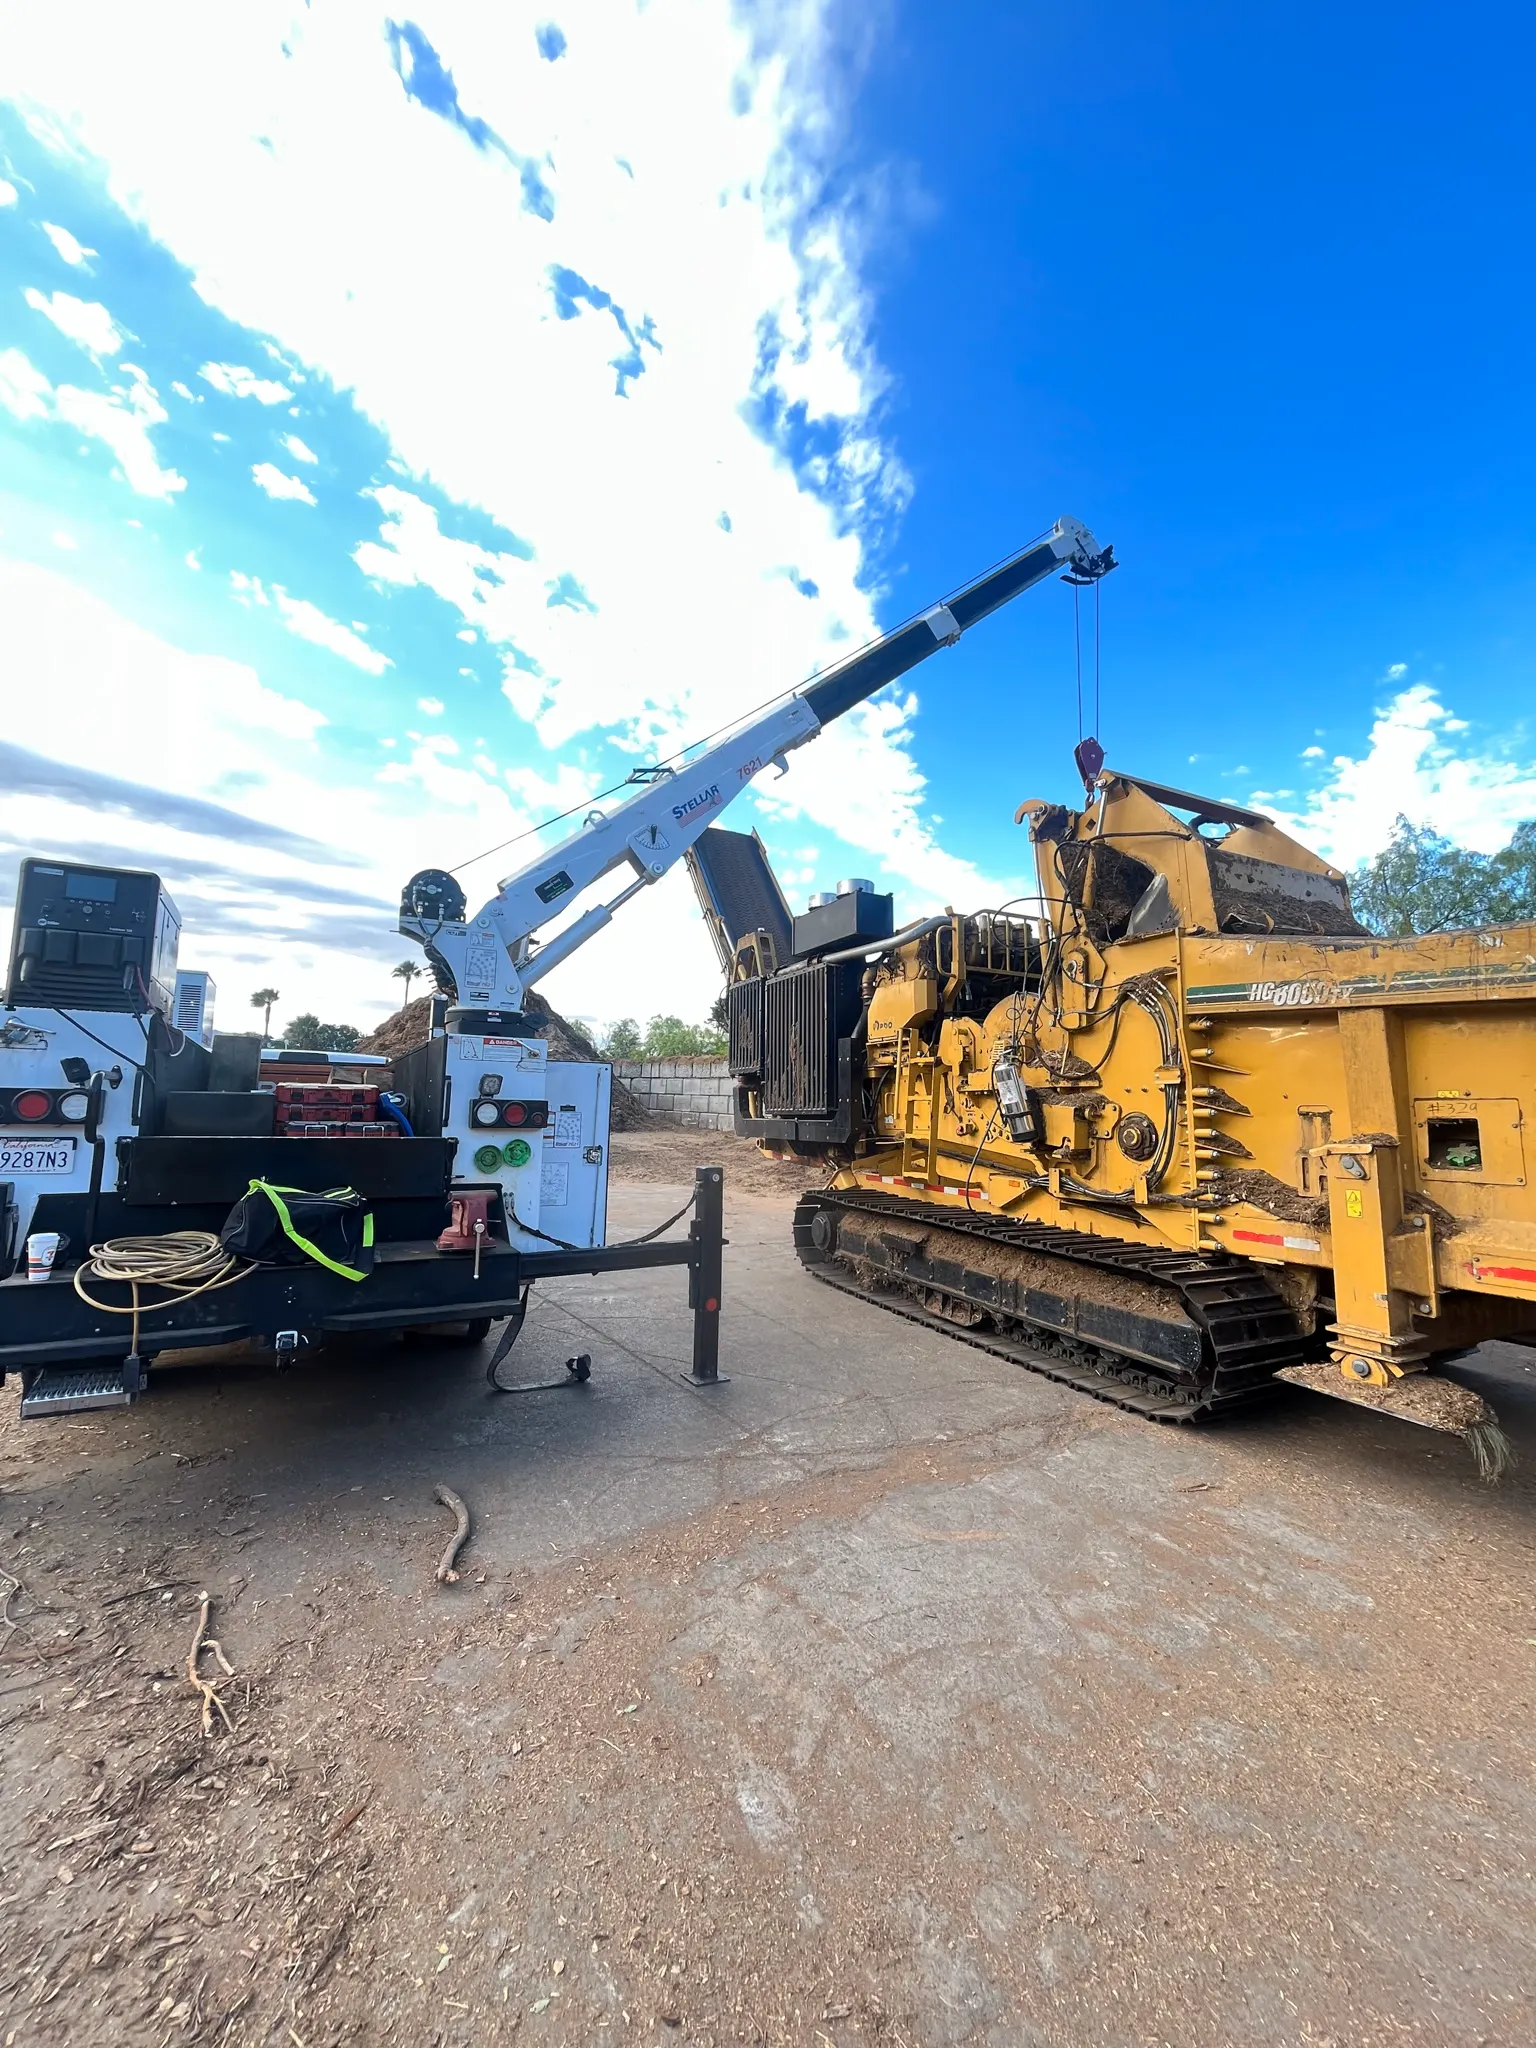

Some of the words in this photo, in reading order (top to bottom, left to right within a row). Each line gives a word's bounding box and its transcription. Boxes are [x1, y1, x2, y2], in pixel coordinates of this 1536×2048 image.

[736, 756, 763, 780] 7621
[672, 784, 720, 820] STELLAR
[0, 1151, 68, 1169] 9287N3
